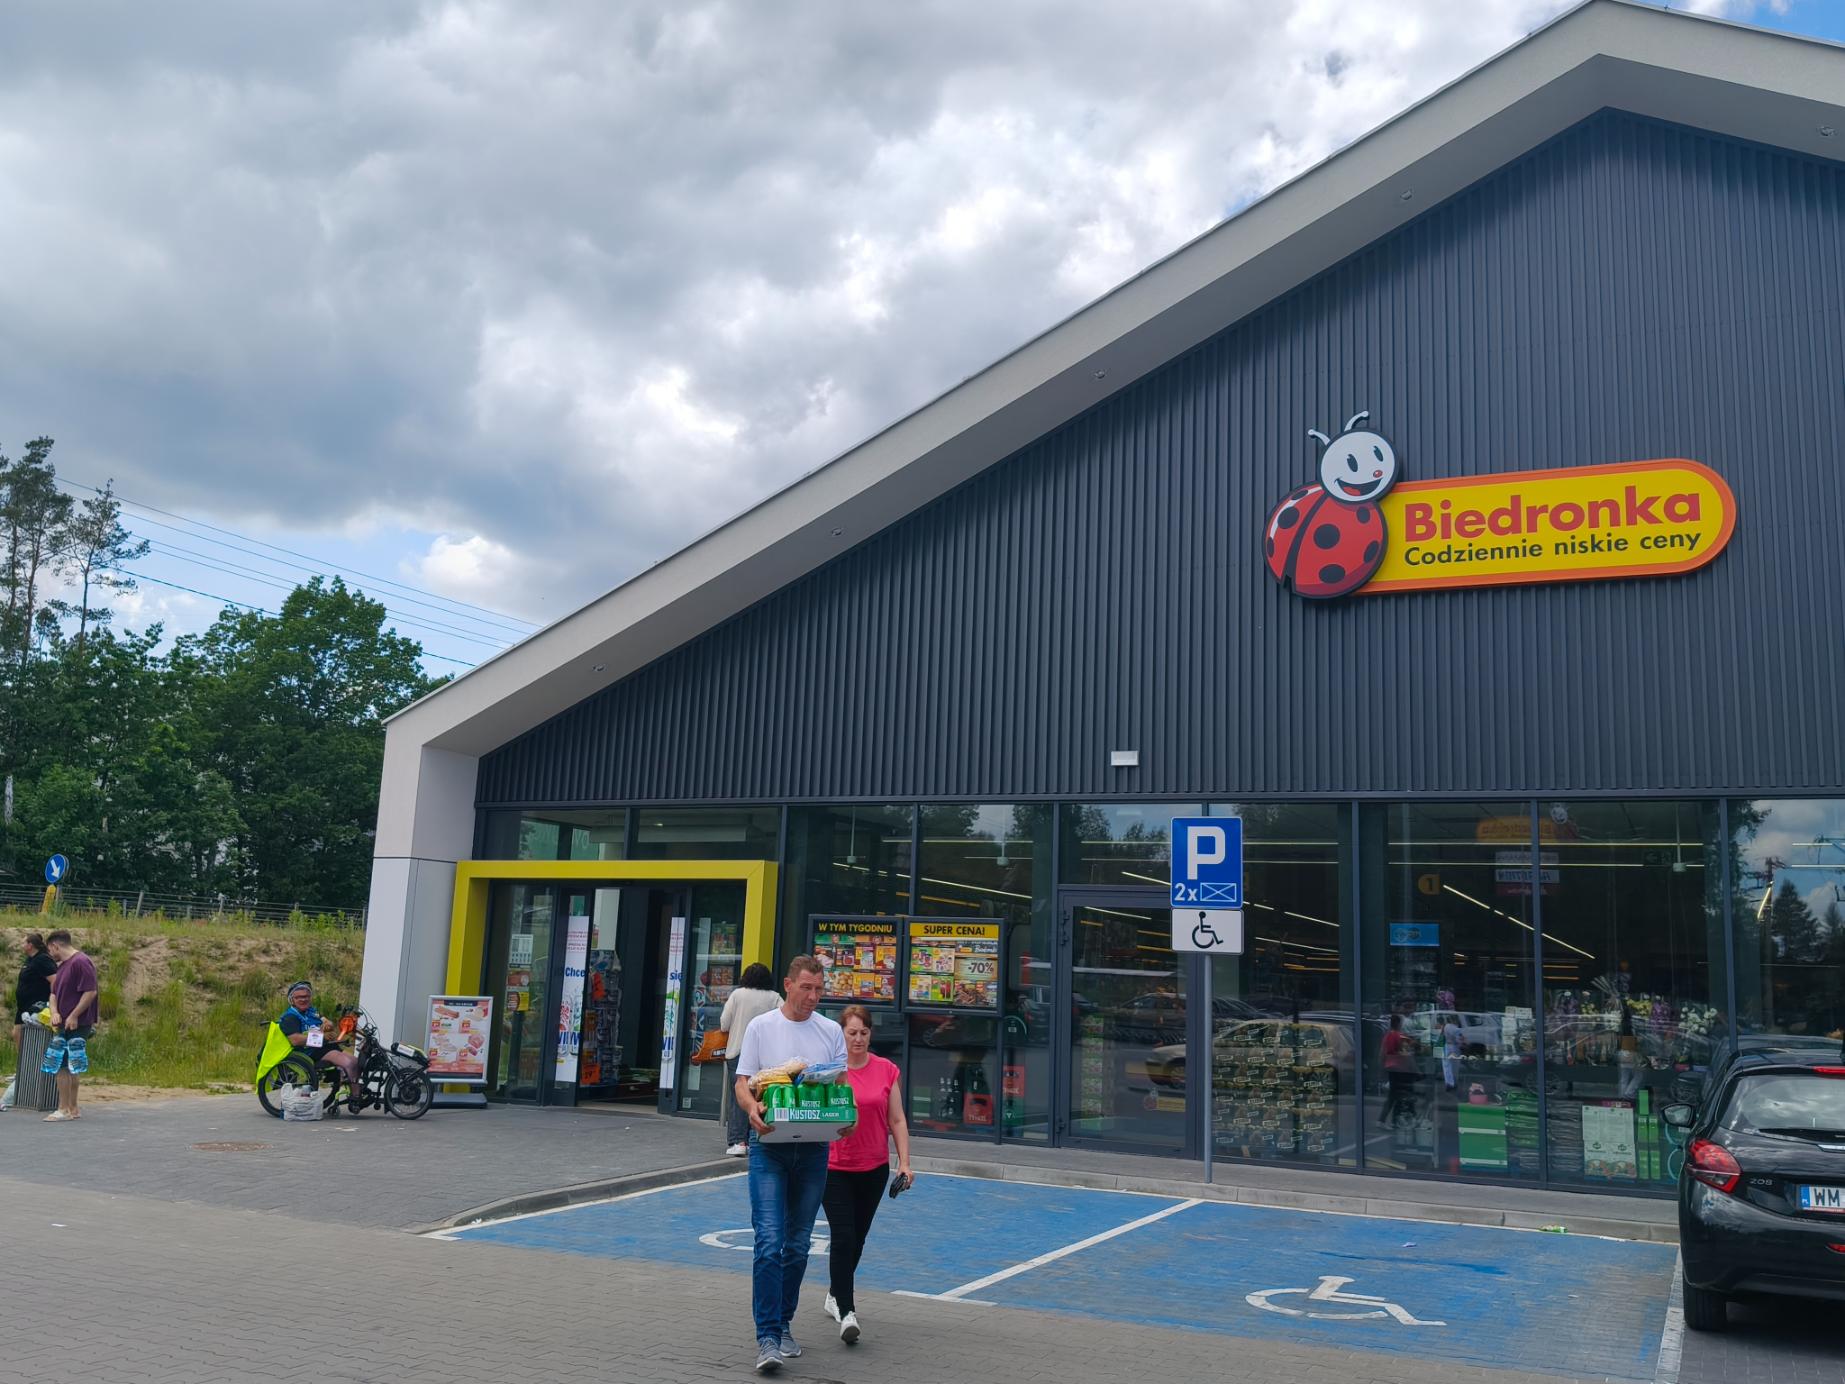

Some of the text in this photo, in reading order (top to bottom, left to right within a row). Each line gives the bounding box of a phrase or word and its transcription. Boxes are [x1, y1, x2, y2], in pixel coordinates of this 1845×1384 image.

[1404, 485, 1701, 542] Biedronka
[1404, 532, 1702, 566] Codziennie niskie ceny
[1187, 826, 1226, 880] P
[818, 922, 893, 933] W TYM TYGODNIU
[923, 925, 953, 934] SUPER
[1813, 1188, 1841, 1207] WM
